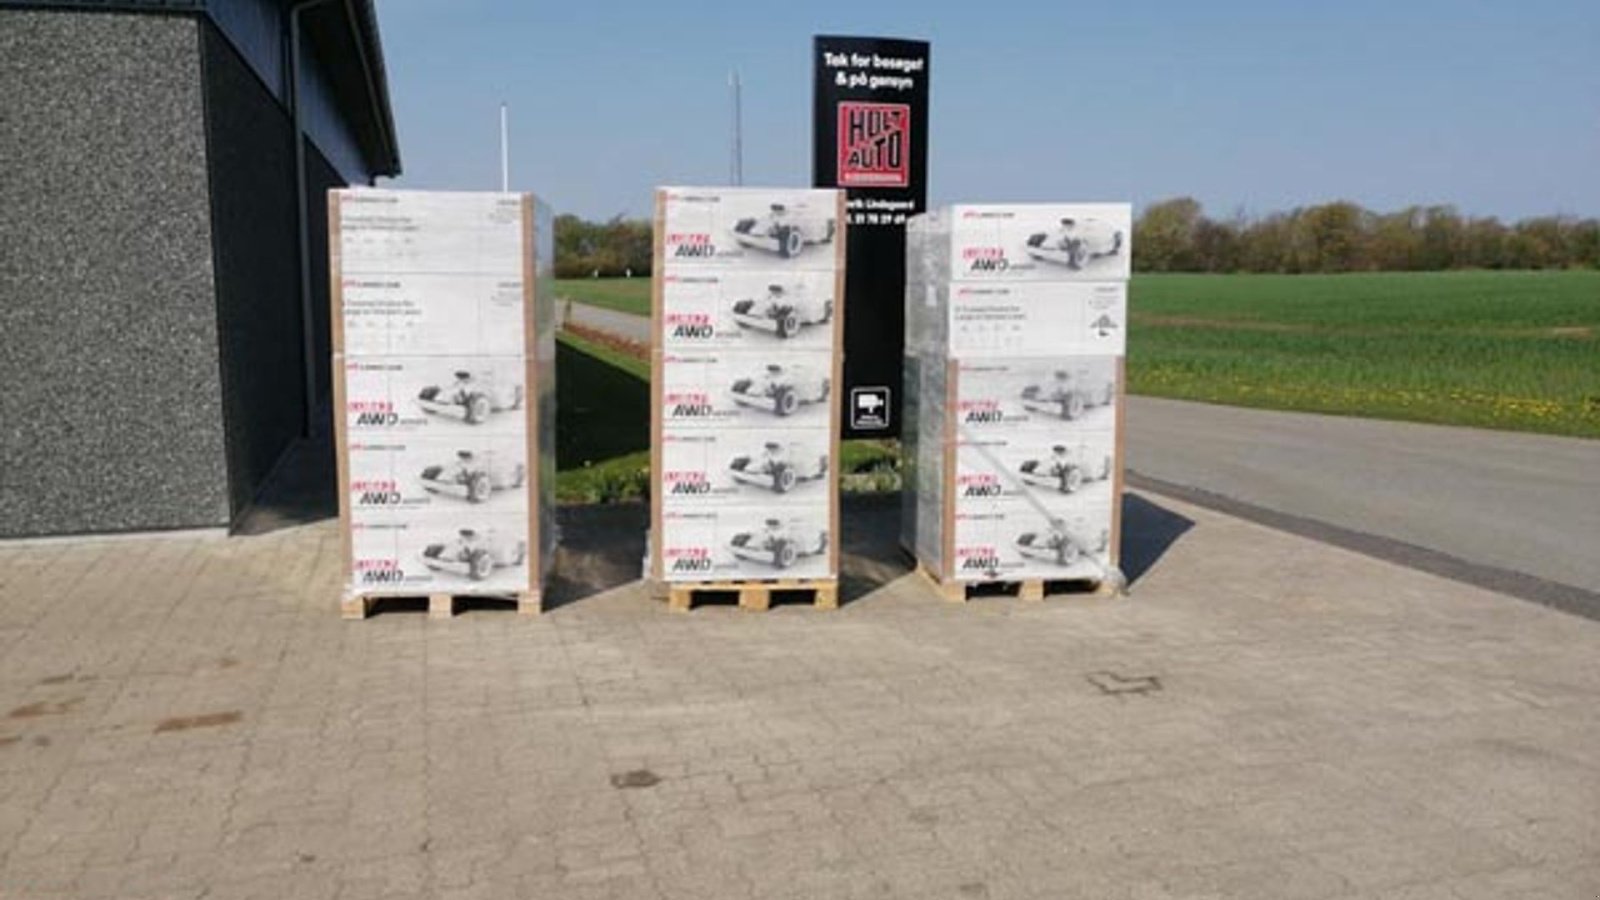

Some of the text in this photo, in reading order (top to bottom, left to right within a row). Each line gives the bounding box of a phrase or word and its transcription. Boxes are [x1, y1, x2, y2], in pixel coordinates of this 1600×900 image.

[824, 53, 848, 67] Tak
[851, 54, 871, 68] for
[835, 71, 847, 86] &
[849, 130, 902, 169] AUTO
